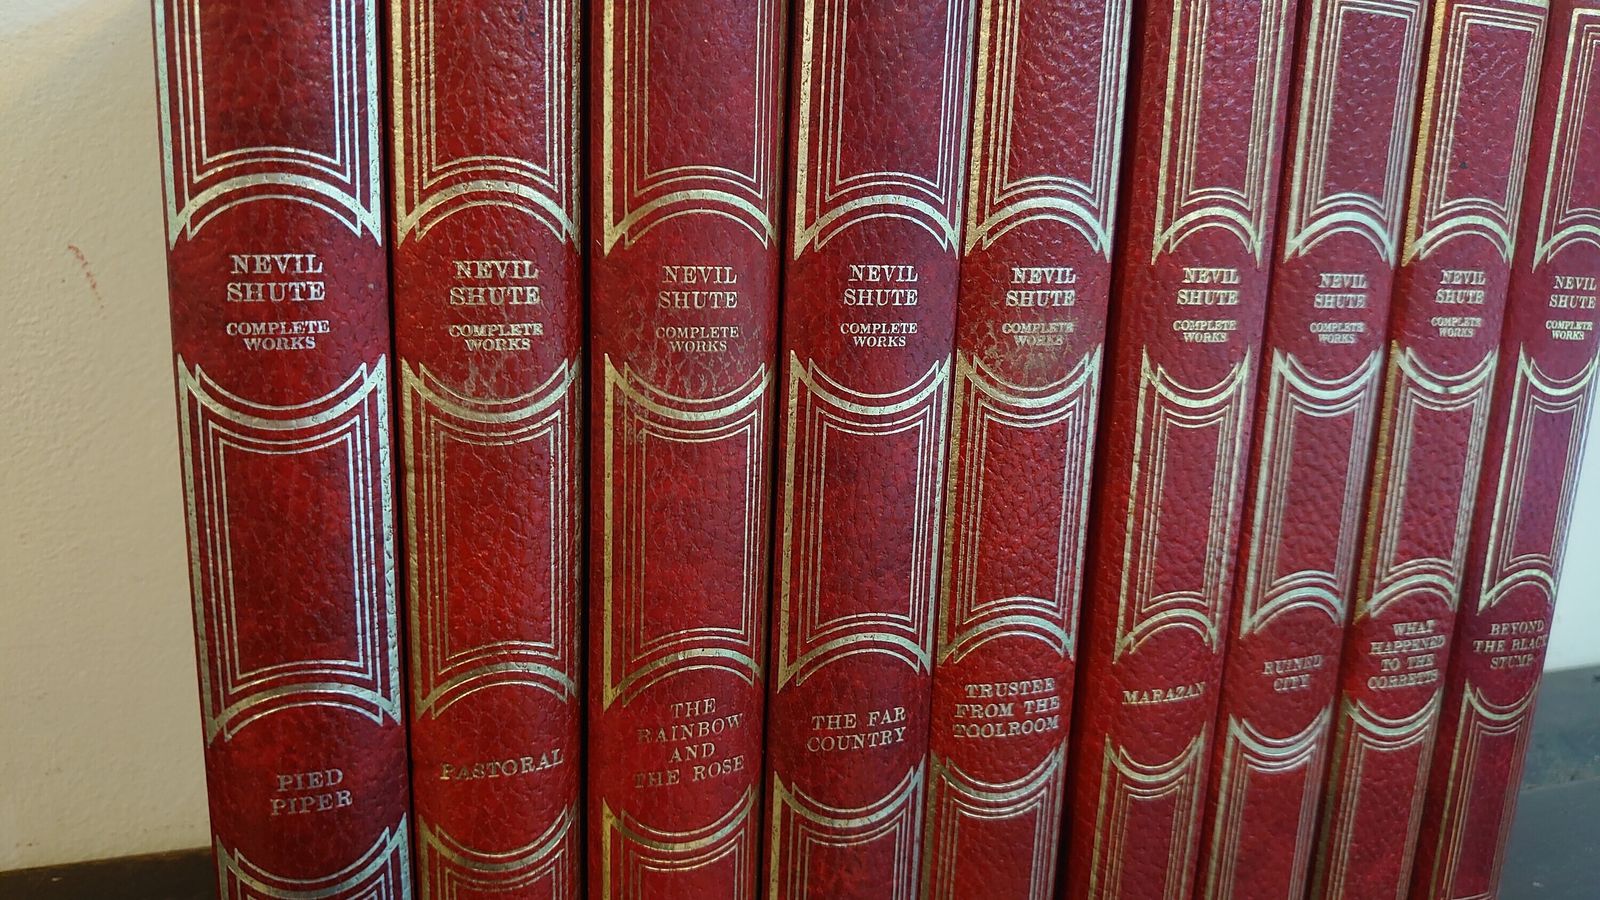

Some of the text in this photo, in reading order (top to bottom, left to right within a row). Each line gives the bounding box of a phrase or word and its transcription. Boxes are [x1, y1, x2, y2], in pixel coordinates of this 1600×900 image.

[231, 254, 323, 274] NEVIL
[455, 261, 539, 280] NEVIL
[662, 266, 738, 284] NEVIL
[848, 265, 918, 282] NEVIL
[1011, 268, 1076, 285] NEVIL
[1182, 268, 1241, 284] NEVIL
[1319, 274, 1368, 289] NEVIL
[1440, 270, 1486, 285] NEVIL
[1553, 276, 1596, 290] NEVIL
[226, 281, 326, 302] SHUTE
[449, 286, 541, 306] SHUTE
[844, 289, 918, 306] SHUTE
[1006, 290, 1076, 307] SHUTE
[1177, 289, 1238, 305] SHUTE
[1435, 289, 1484, 304] SHUTE
[659, 291, 738, 310] SHUTE
[1314, 294, 1366, 308] SHUTE
[1549, 295, 1596, 309] SHUTE
[226, 320, 330, 335] COMPLETE
[449, 323, 543, 337] COMPLETE
[840, 322, 918, 334] COMPLETE
[1002, 322, 1074, 334] COMPLETE
[1173, 320, 1236, 332] COMPLETE
[1310, 322, 1364, 333] COMPLETE
[1431, 317, 1482, 327] COMPLETE
[1546, 320, 1593, 331] COMPLETE
[656, 325, 740, 338] COMPLETE
[1183, 332, 1227, 343] WORKS
[1318, 333, 1356, 343] WORKS
[1439, 327, 1474, 338] WORKS
[1551, 330, 1585, 340] WORKS
[243, 335, 316, 351] WORKS
[464, 337, 530, 351] WORKS
[670, 340, 728, 353] WORKS
[853, 335, 906, 348] WORKS
[1014, 335, 1064, 346] WORKS
[1392, 620, 1435, 635] WHAT
[1490, 619, 1544, 635] BEYOND
[1370, 635, 1445, 655] HAPPENED
[1472, 639, 1505, 652] THE
[1263, 655, 1324, 675] RUINED
[1381, 654, 1434, 672] TO THE
[1489, 654, 1534, 669] STUMP
[964, 677, 1055, 699] TRUSTEE
[1273, 674, 1311, 692] CITY
[1121, 682, 1206, 705] MARAZAN
[670, 698, 716, 718] THE
[954, 696, 1060, 719] FROM THE
[812, 706, 907, 732] THE FAR
[953, 715, 1060, 738] TOOLROOM
[636, 713, 743, 746] RAINBOW
[807, 727, 906, 753] COUNTRY
[668, 745, 715, 761] AND
[440, 748, 564, 781] PASTORAL
[634, 754, 744, 789] THE ROSE
[276, 768, 344, 792] PIED
[270, 790, 353, 817] PIPER
